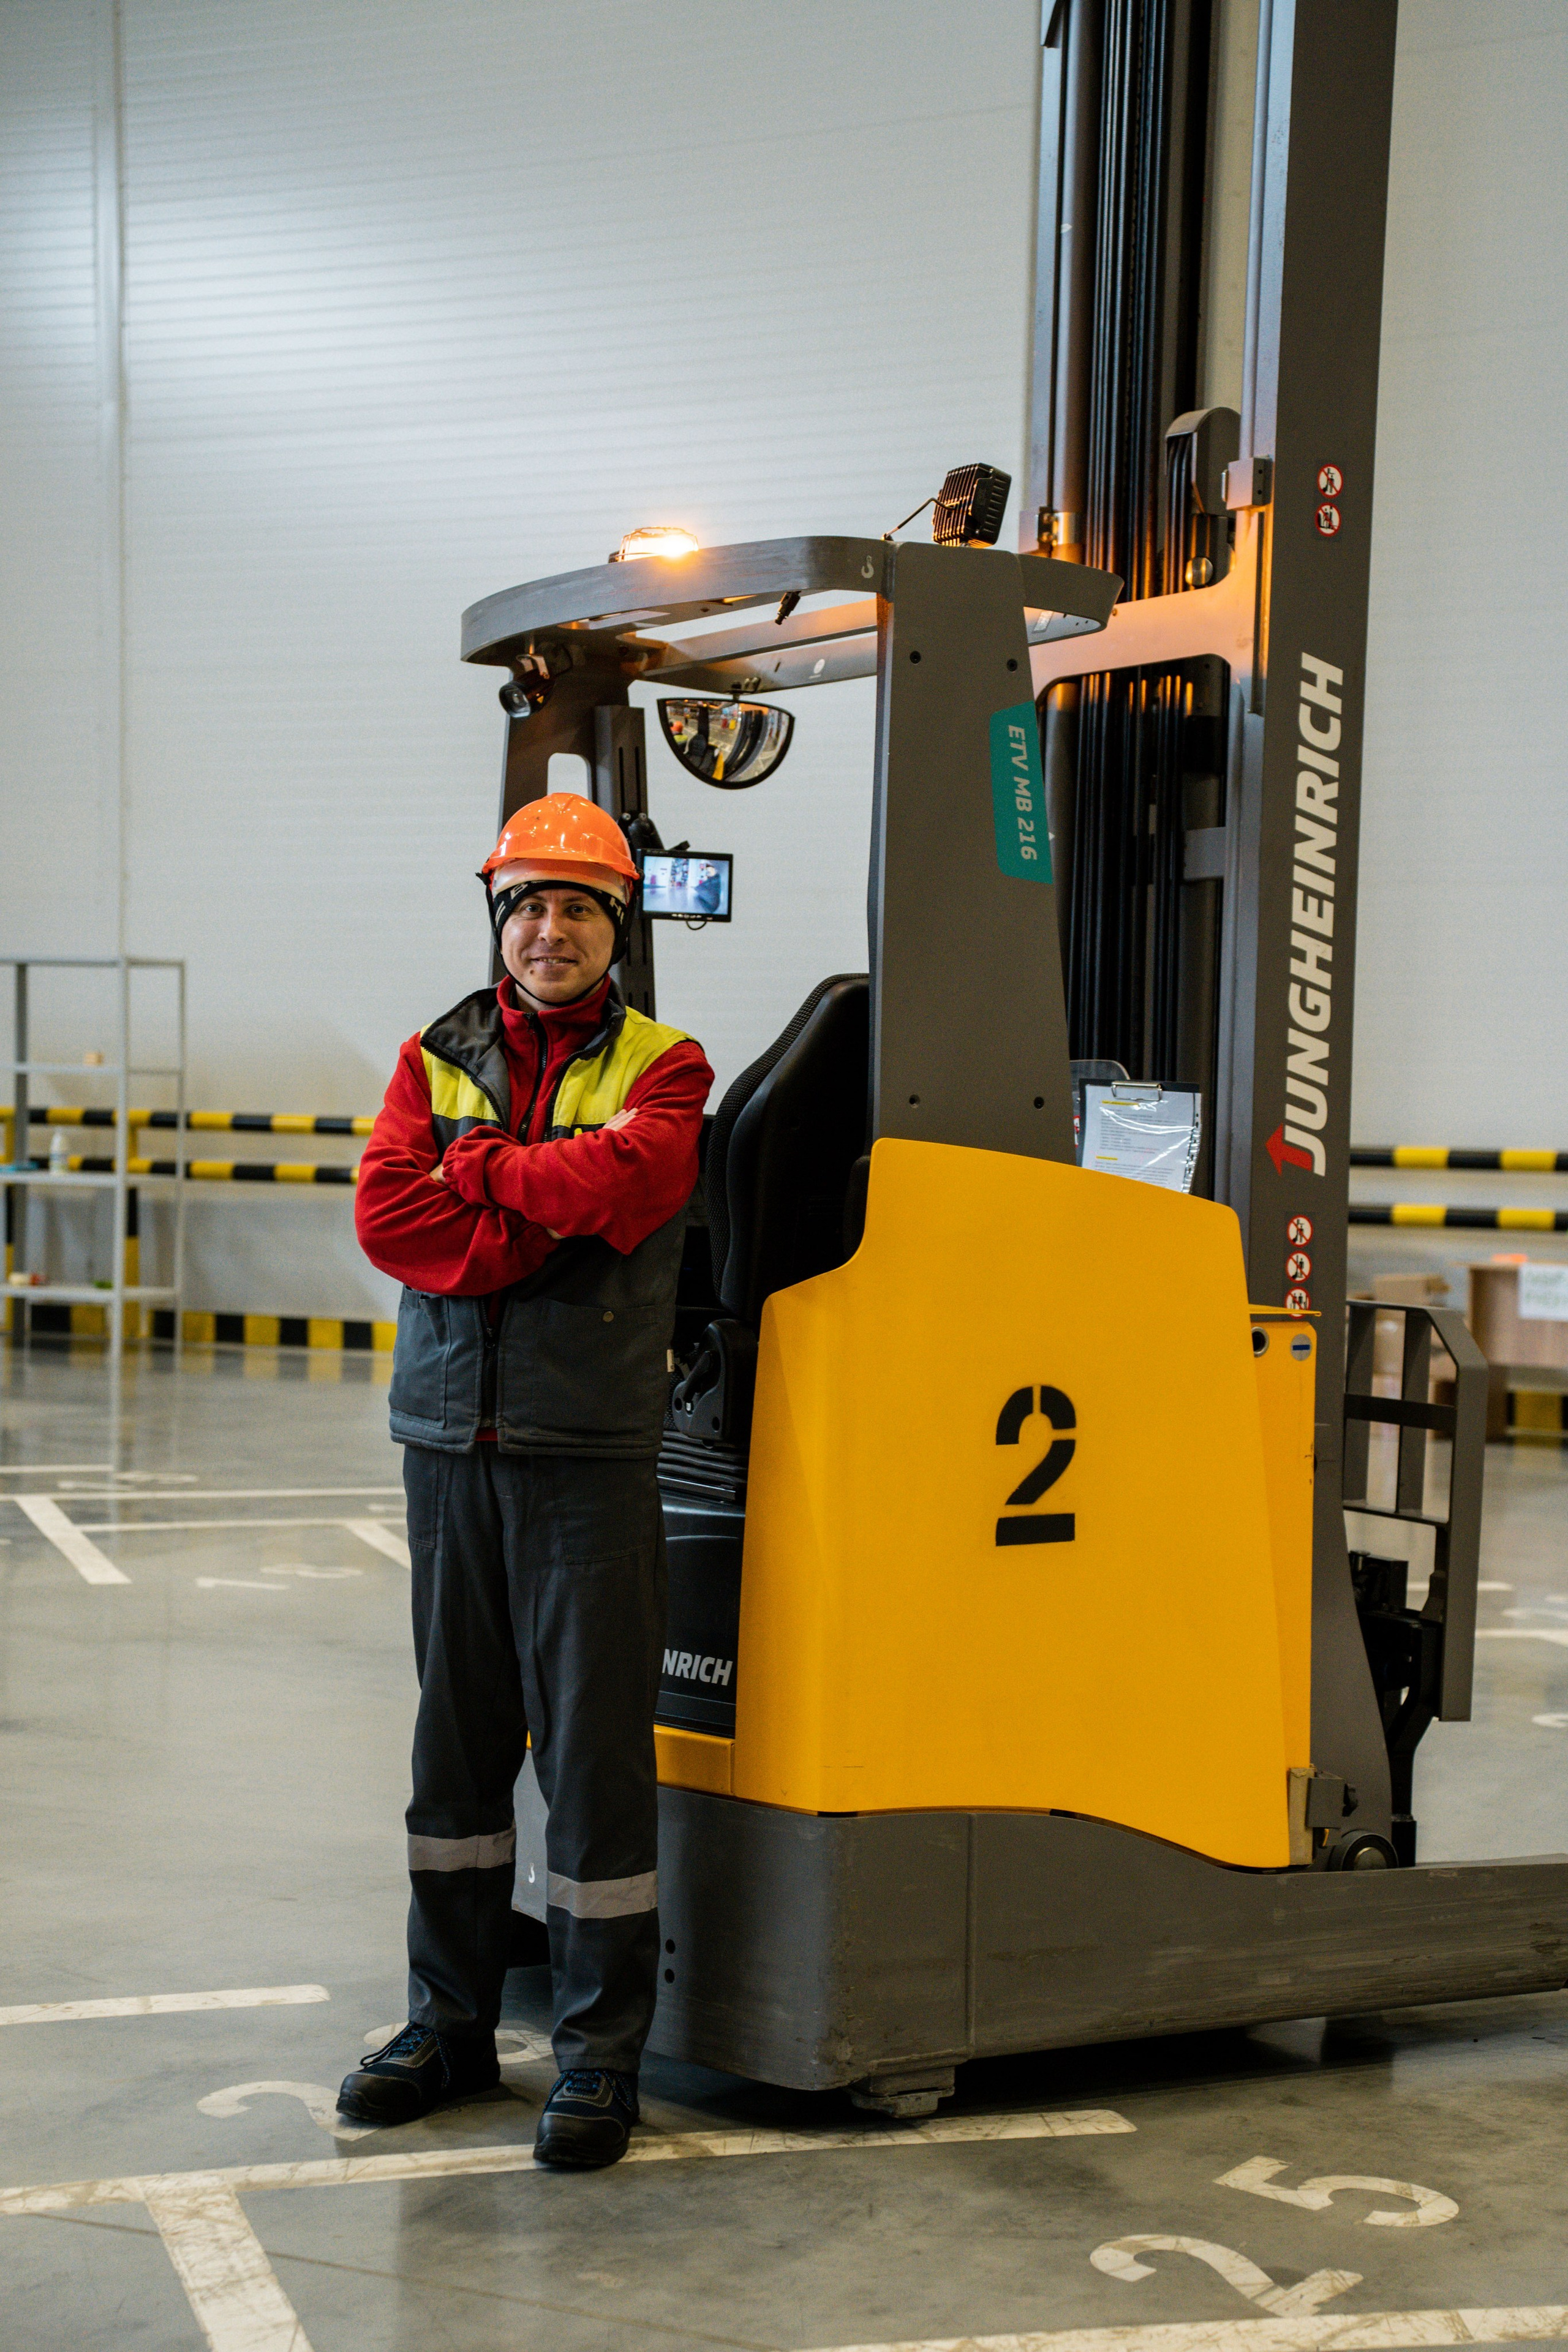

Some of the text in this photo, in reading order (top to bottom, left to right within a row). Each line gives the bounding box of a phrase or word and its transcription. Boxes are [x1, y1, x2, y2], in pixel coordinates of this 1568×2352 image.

[1008, 725, 1037, 860] ETV MB 216
[1283, 652, 1343, 1177] JUNGHEINRICH
[995, 1384, 1077, 1547] 2
[662, 1648, 733, 1686] NRICH
[1089, 2155, 1460, 2318] 25
